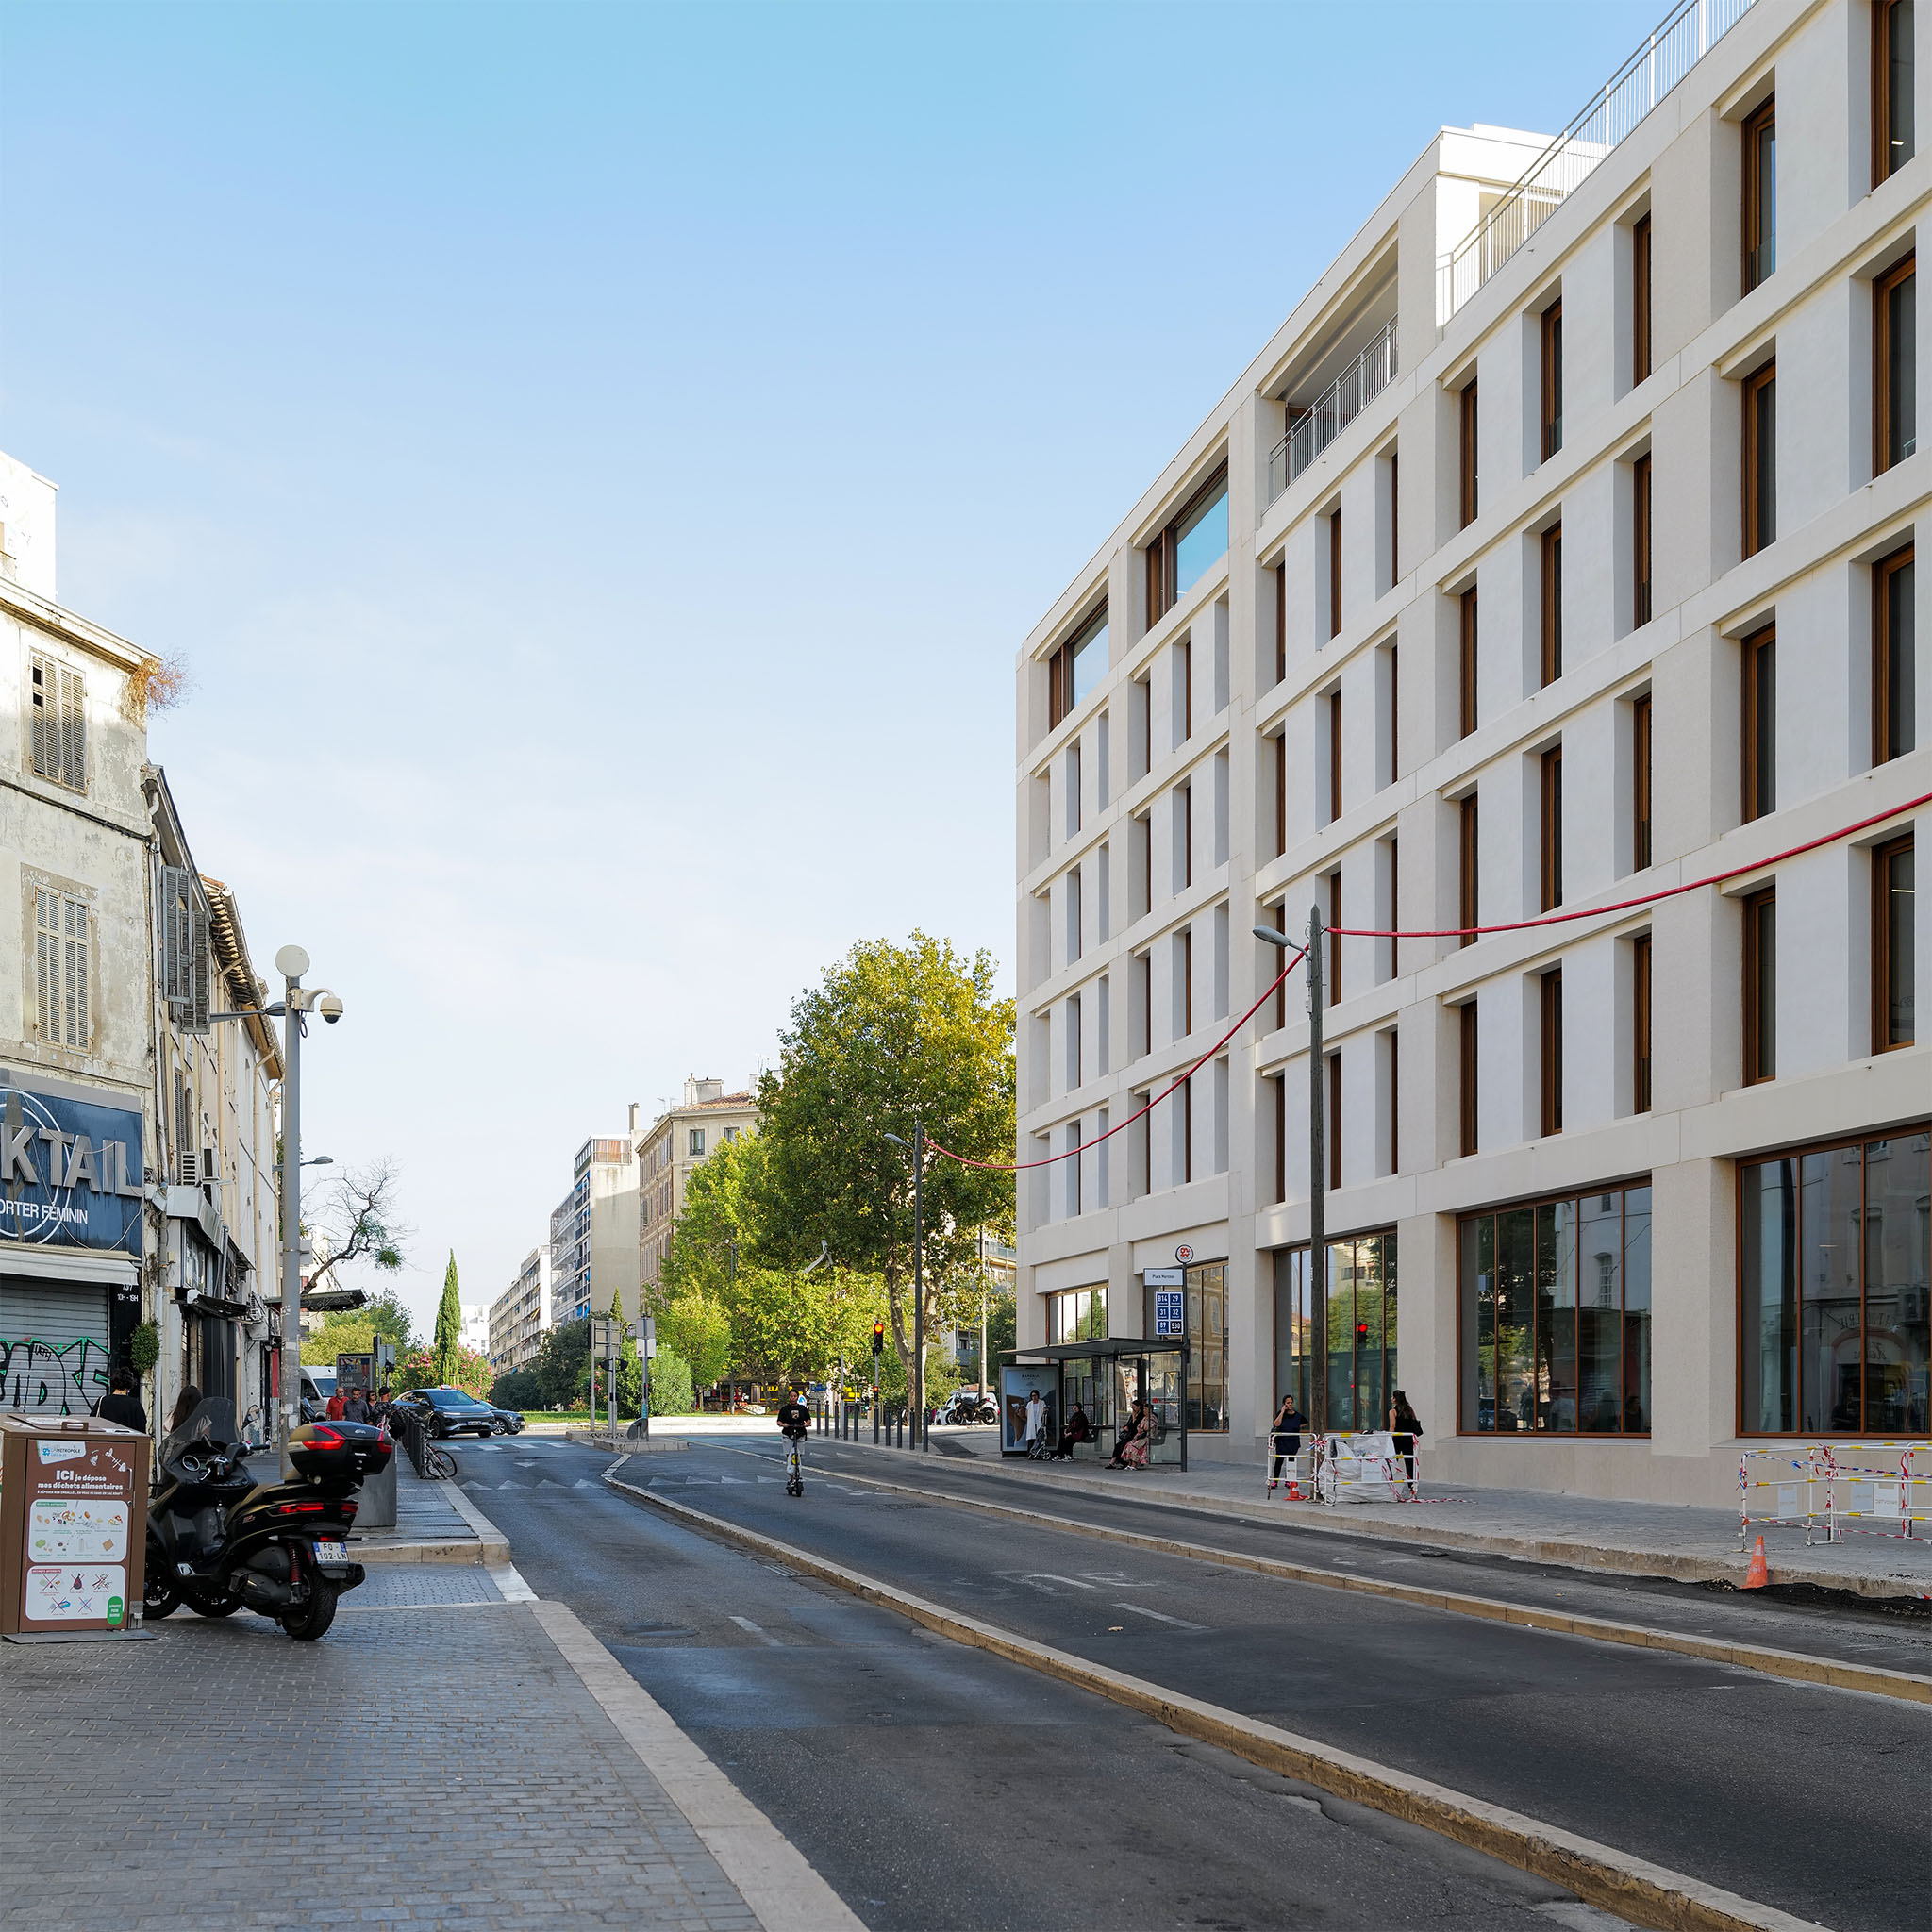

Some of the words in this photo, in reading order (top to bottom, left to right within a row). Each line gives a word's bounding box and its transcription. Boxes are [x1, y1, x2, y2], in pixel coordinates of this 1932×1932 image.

[0, 1122, 143, 1198] KTAIL
[57, 1470, 74, 1481] ICI
[53, 1481, 80, 1490] déchets
